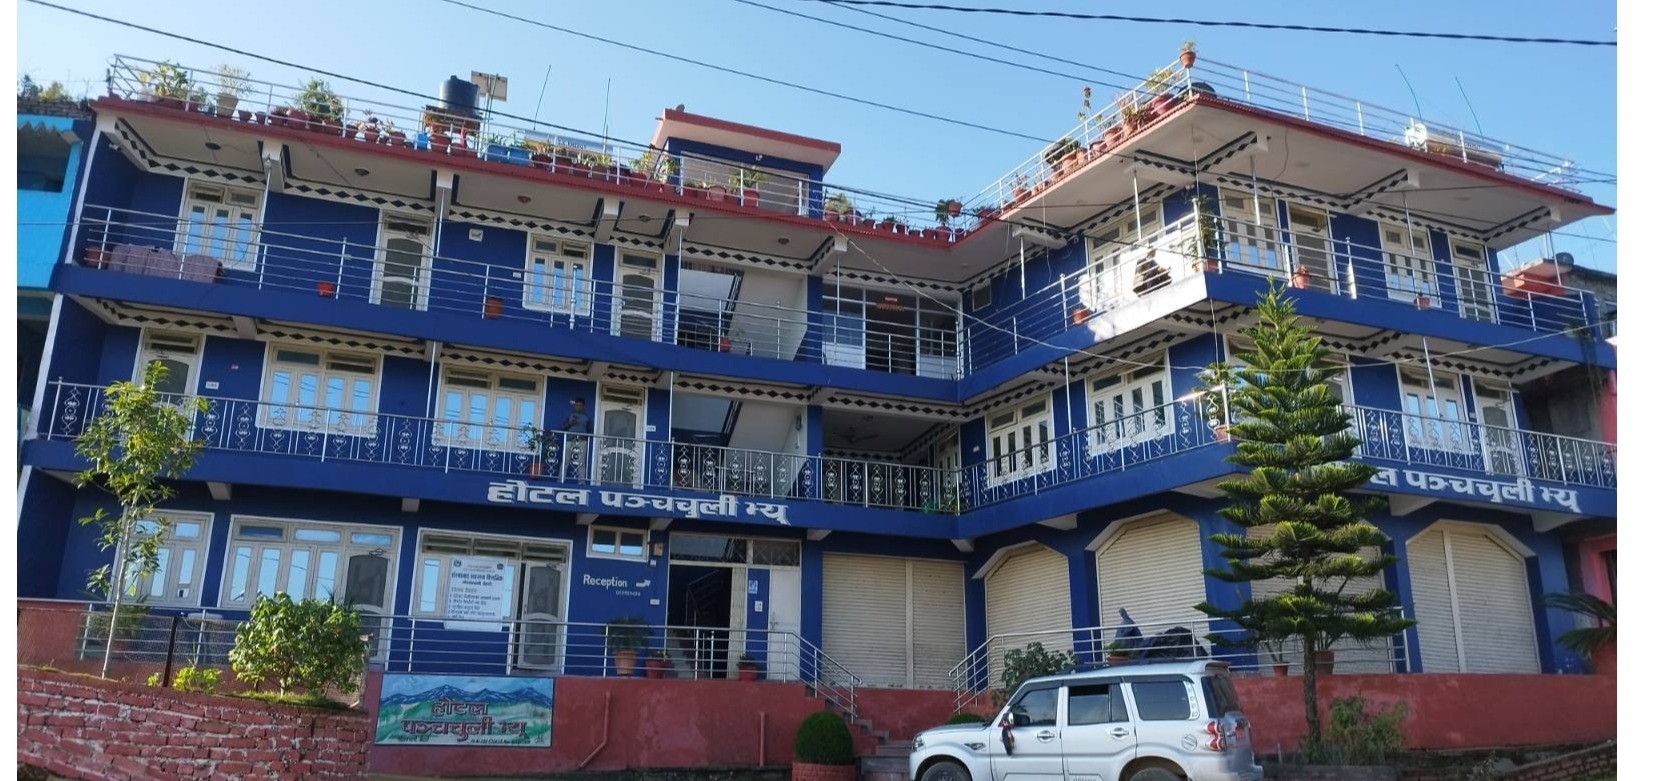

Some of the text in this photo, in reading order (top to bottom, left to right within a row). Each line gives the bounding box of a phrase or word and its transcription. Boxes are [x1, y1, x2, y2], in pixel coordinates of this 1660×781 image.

[487, 479, 592, 506] होटल
[583, 574, 627, 590] Reception
[432, 697, 488, 716] होटल
